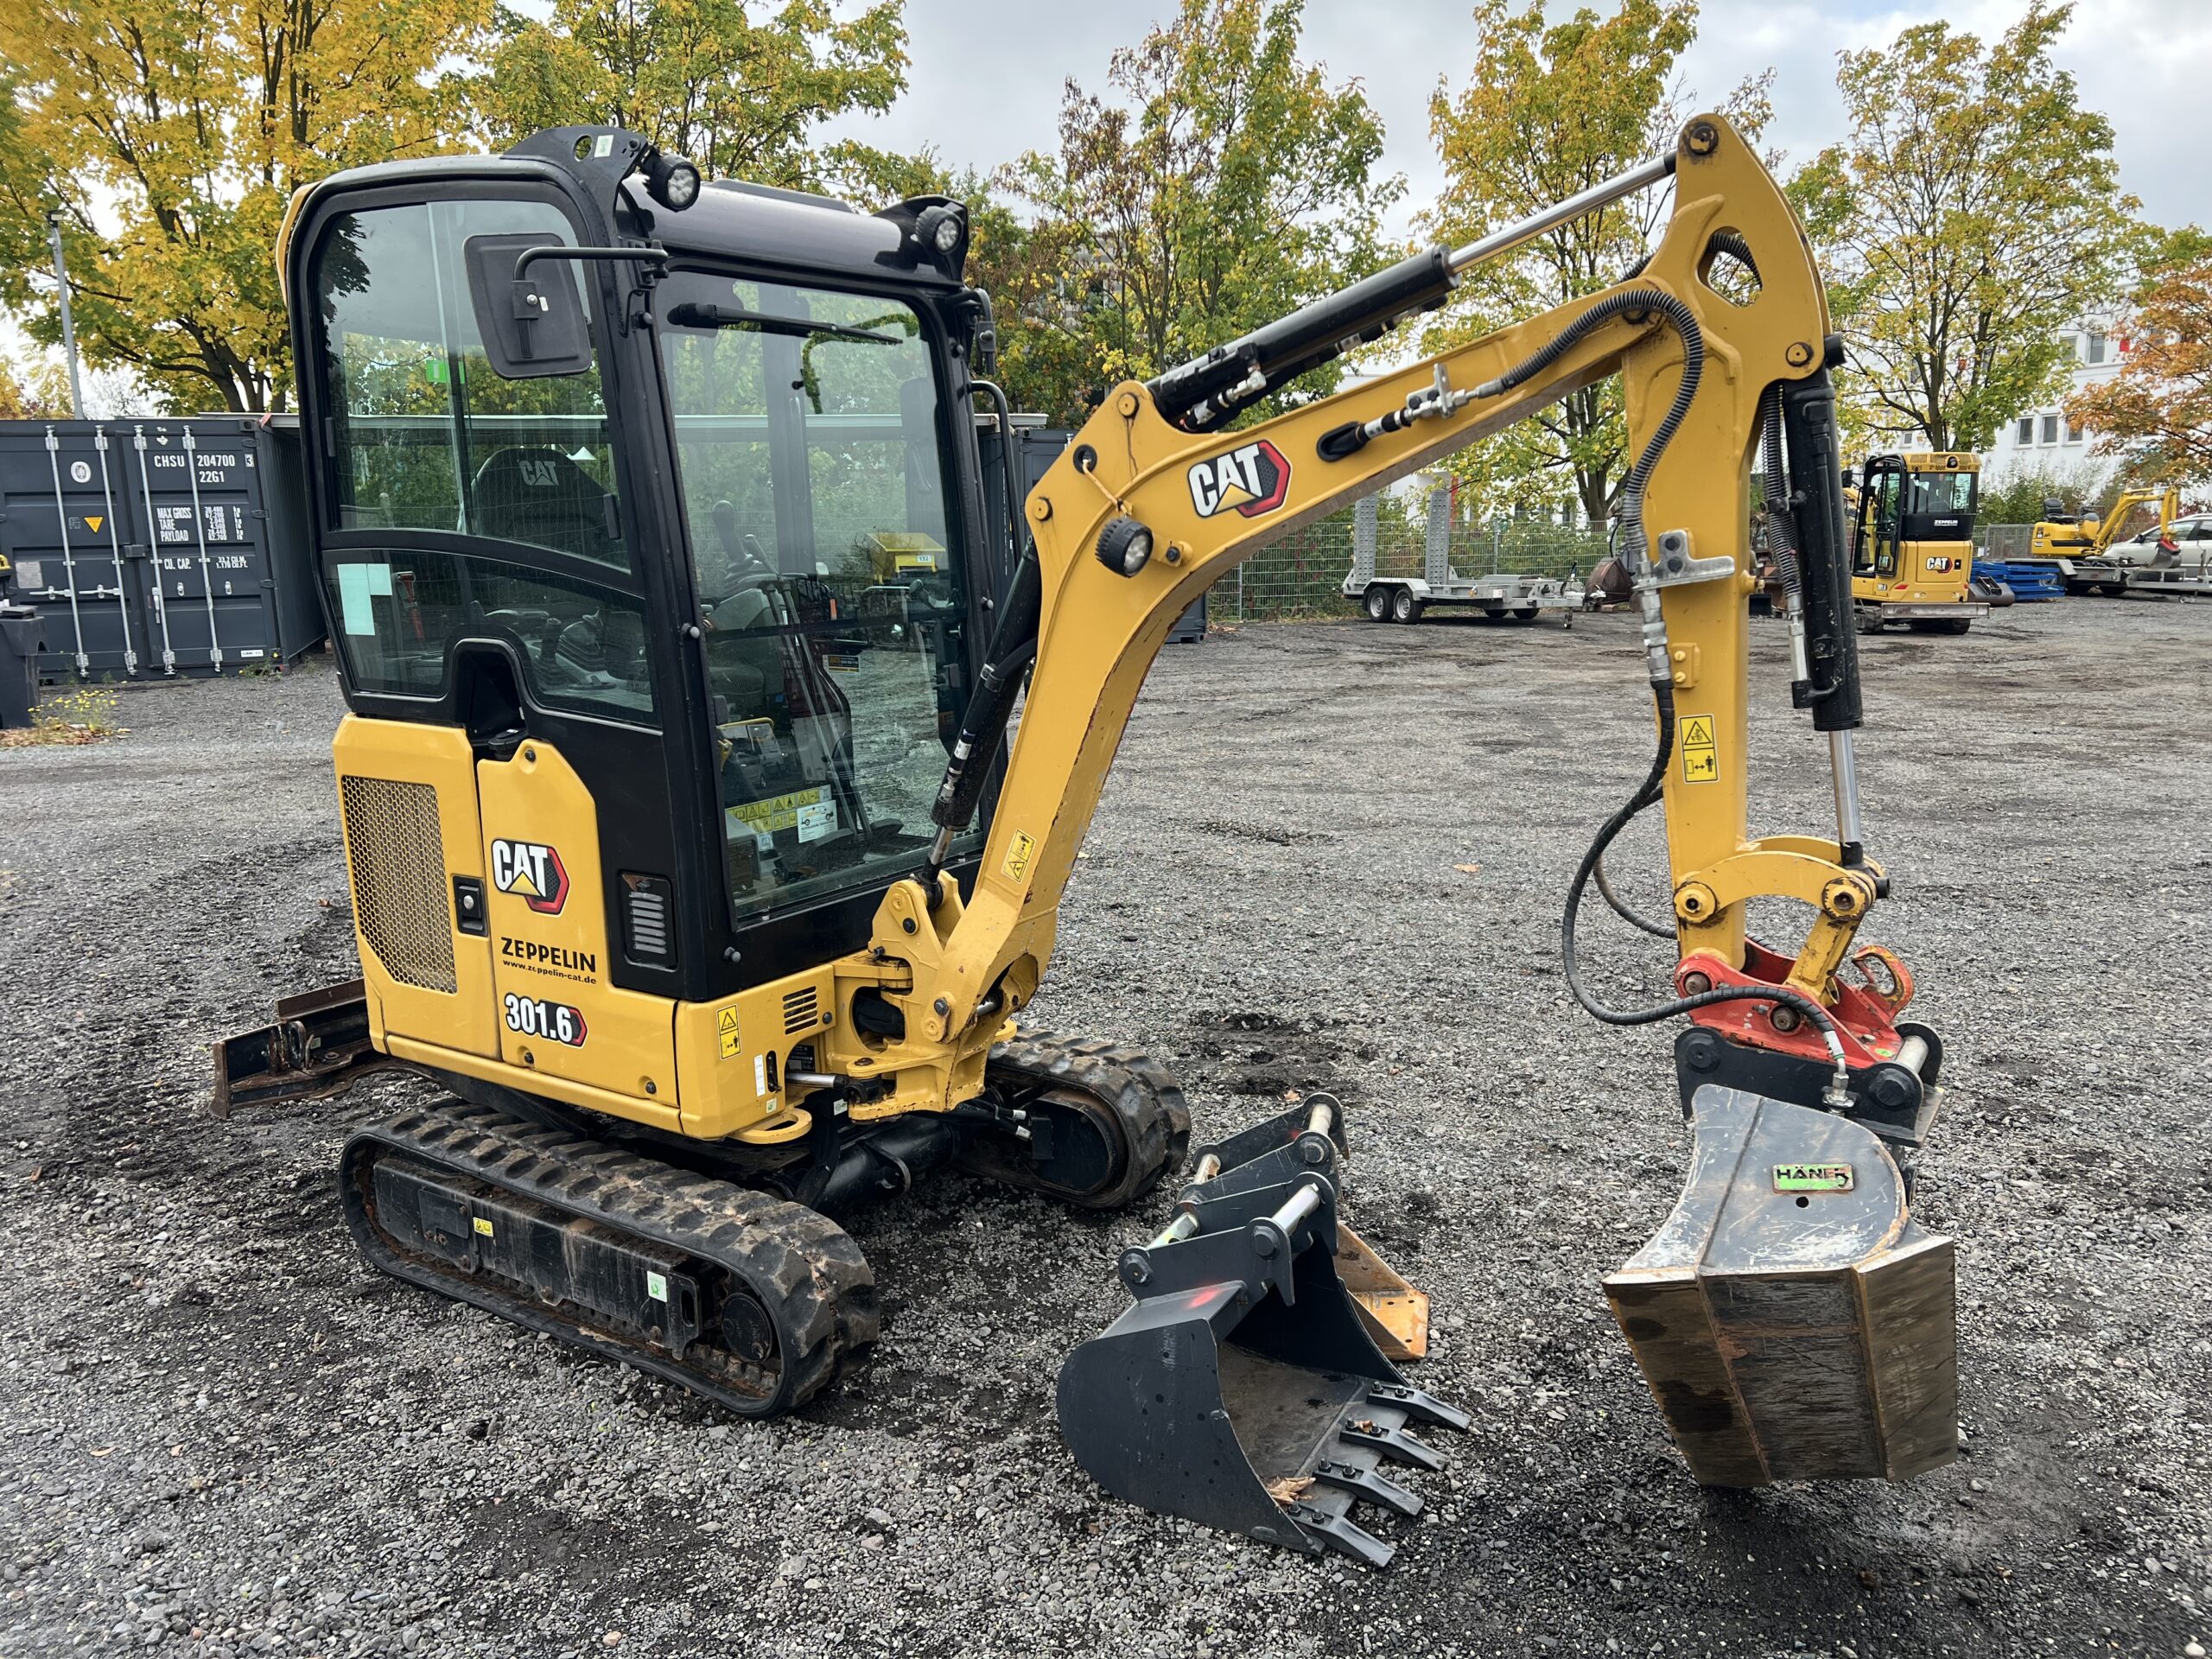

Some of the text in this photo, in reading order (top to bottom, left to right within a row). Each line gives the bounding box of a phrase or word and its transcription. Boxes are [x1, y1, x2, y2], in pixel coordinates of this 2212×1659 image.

[154, 454, 254, 467] CHSU 204700 3
[199, 471, 225, 482] 22G1
[519, 461, 559, 486] CAT
[1188, 443, 1262, 517] CAT
[156, 507, 192, 518] MAX GROSS
[159, 519, 175, 530] TARE
[160, 530, 189, 542] PAYLOAD
[164, 558, 192, 569] CU. CAP.
[1927, 557, 1948, 570] CAT
[493, 840, 548, 897] CAT
[501, 937, 596, 973] ZEPPELIN
[505, 994, 573, 1042] 301.6
